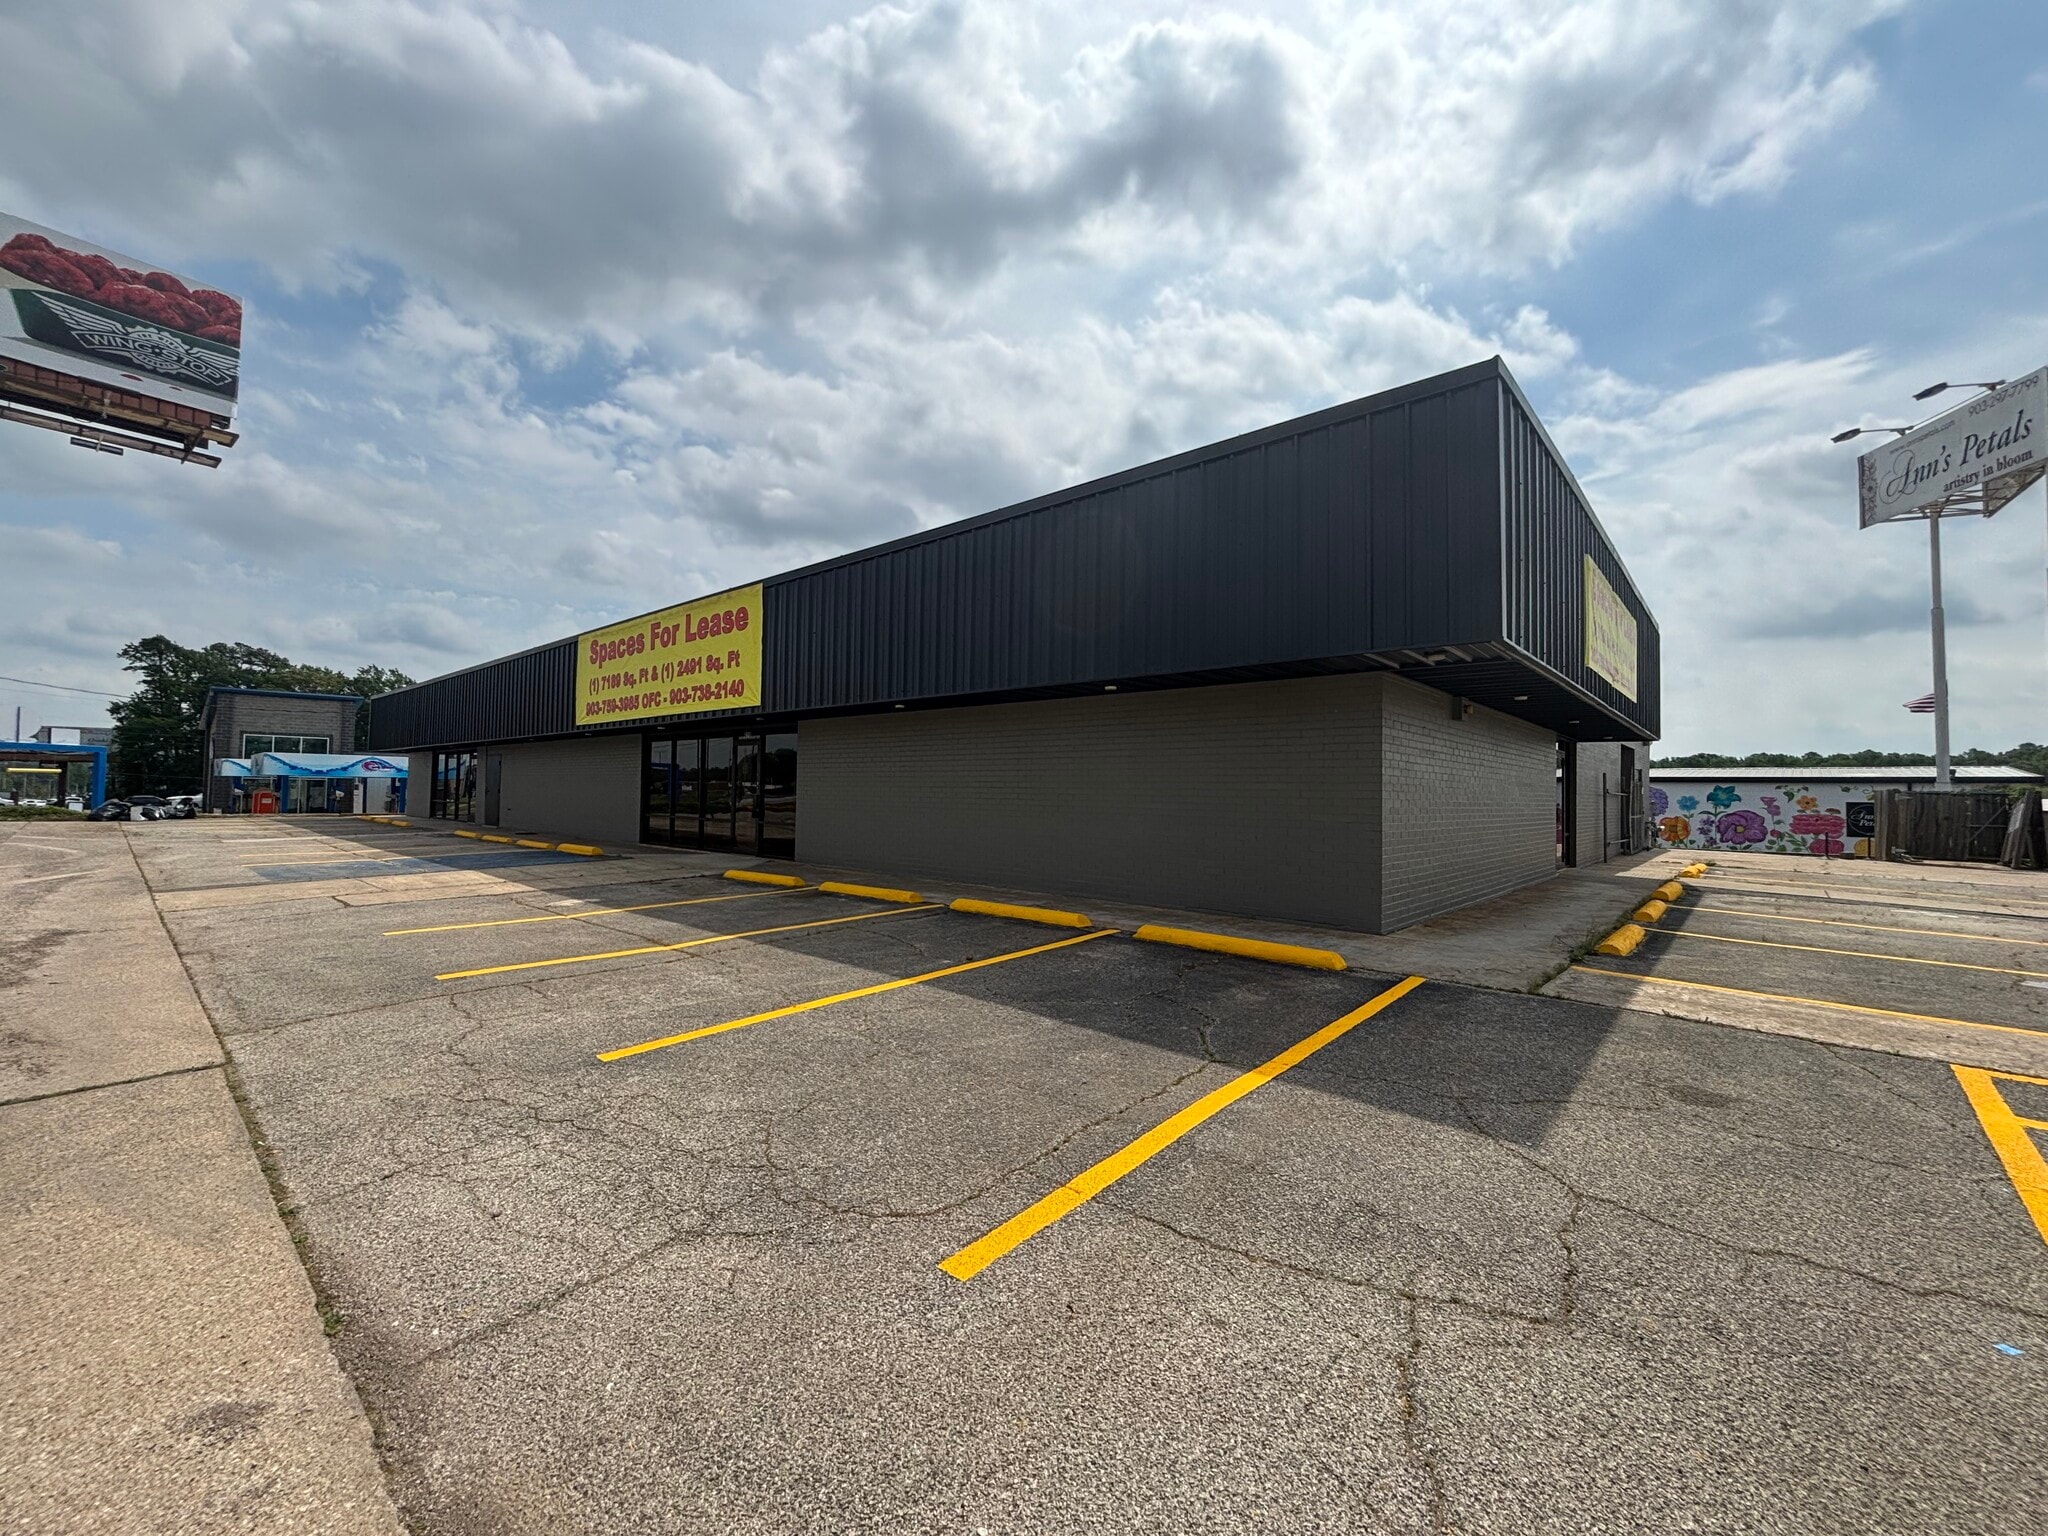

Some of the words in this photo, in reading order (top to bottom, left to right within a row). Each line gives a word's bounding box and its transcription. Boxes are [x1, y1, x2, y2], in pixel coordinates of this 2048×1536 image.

[1879, 445, 1952, 504] Ann's
[1959, 409, 2033, 467] Petals
[1943, 471, 1980, 492] artistry
[1982, 464, 1994, 477] in
[1996, 450, 2033, 471] bloom
[589, 632, 645, 669] Spaces
[650, 621, 680, 651] For
[685, 606, 749, 643] Lease
[589, 677, 600, 696] (1)
[623, 671, 637, 689] Sq.
[639, 667, 649, 684] Ft
[651, 665, 659, 681] &
[661, 661, 675, 684] (1)
[677, 656, 702, 677] 2491
[706, 654, 724, 674] Sq.
[727, 649, 740, 669] Ft
[641, 691, 662, 709] OFC
[669, 679, 745, 705] 903-738-2140
